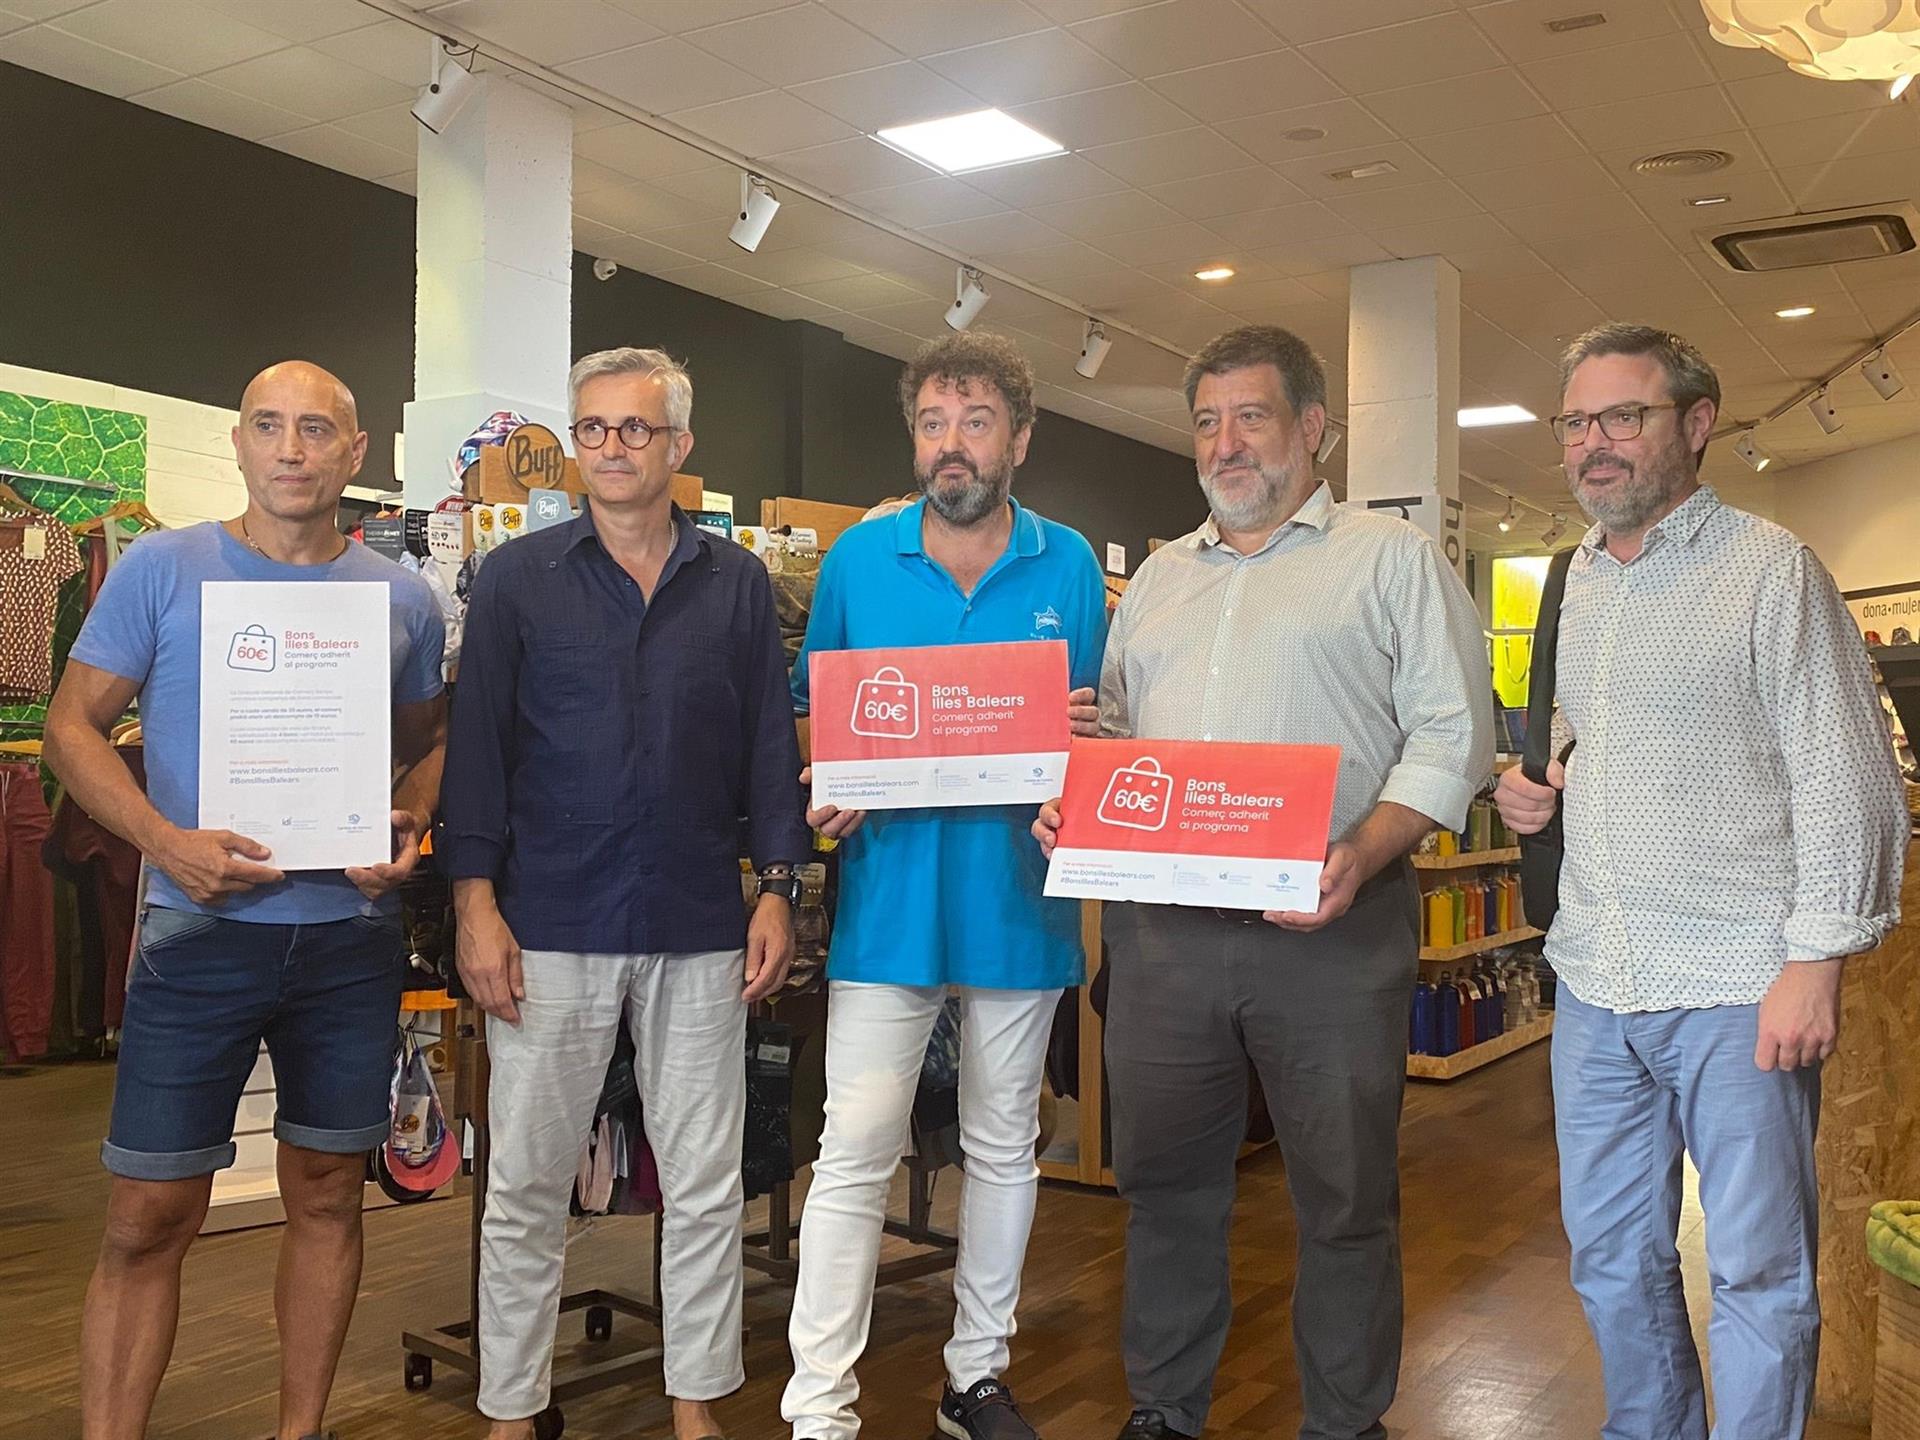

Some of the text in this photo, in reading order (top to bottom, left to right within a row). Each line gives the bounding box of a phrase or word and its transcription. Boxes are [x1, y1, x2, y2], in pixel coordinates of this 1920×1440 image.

[285, 630, 315, 640] Bons
[285, 639, 359, 650] Illes Balears
[237, 646, 268, 661] 60€
[284, 651, 318, 660] Comerç
[295, 661, 338, 669] programa
[932, 685, 969, 697] Bons
[932, 694, 1025, 709] Illes Balears
[864, 701, 908, 722] 60€
[932, 710, 1015, 723] Comerç adherit
[932, 724, 998, 737] al programa
[827, 779, 920, 790] www.bonsillesbalears.com
[1186, 778, 1227, 792] Bons
[1113, 789, 1159, 813] 60€
[1184, 791, 1284, 808] Illes Balears
[1181, 808, 1269, 821] Comerç adherit
[1192, 822, 1249, 834] programa
[1061, 868, 1156, 880] www.bonsillesbalears.com
